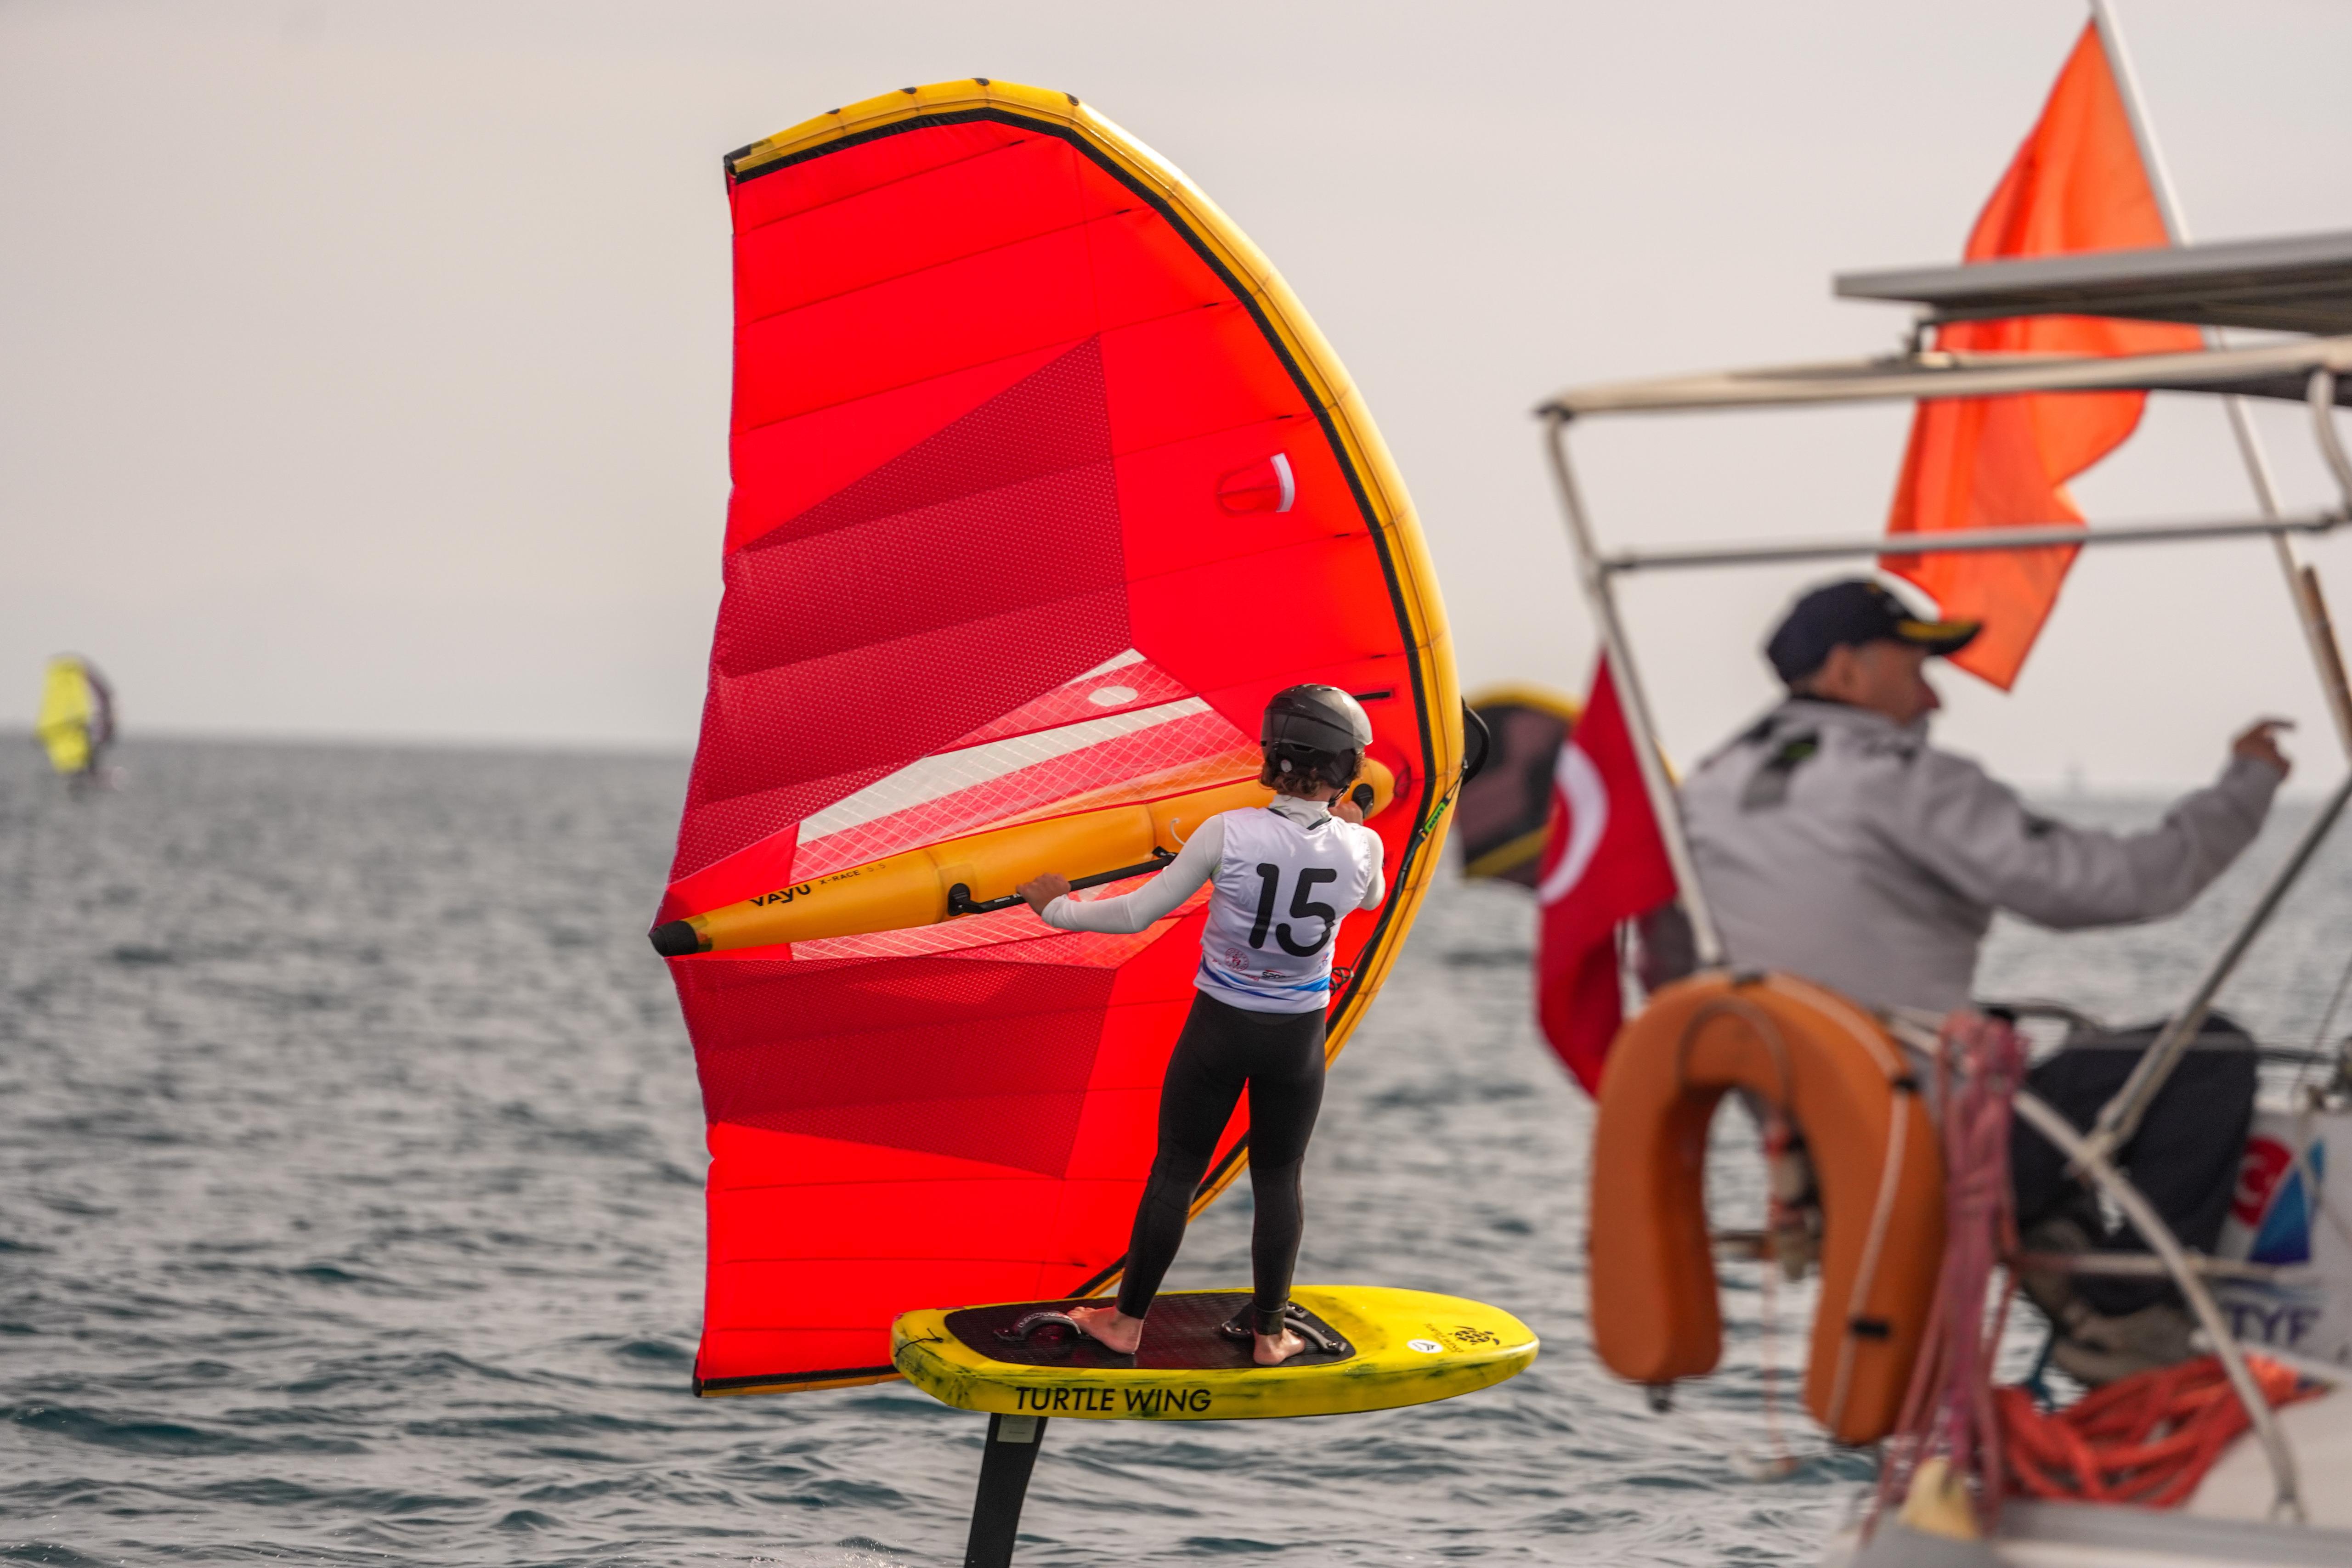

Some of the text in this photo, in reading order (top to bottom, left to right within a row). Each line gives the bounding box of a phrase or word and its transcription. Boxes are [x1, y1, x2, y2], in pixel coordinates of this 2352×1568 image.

[819, 870, 861, 885] X-RACE
[1249, 863, 1337, 957] 15
[1015, 1387, 1212, 1412] TURTLE WING
